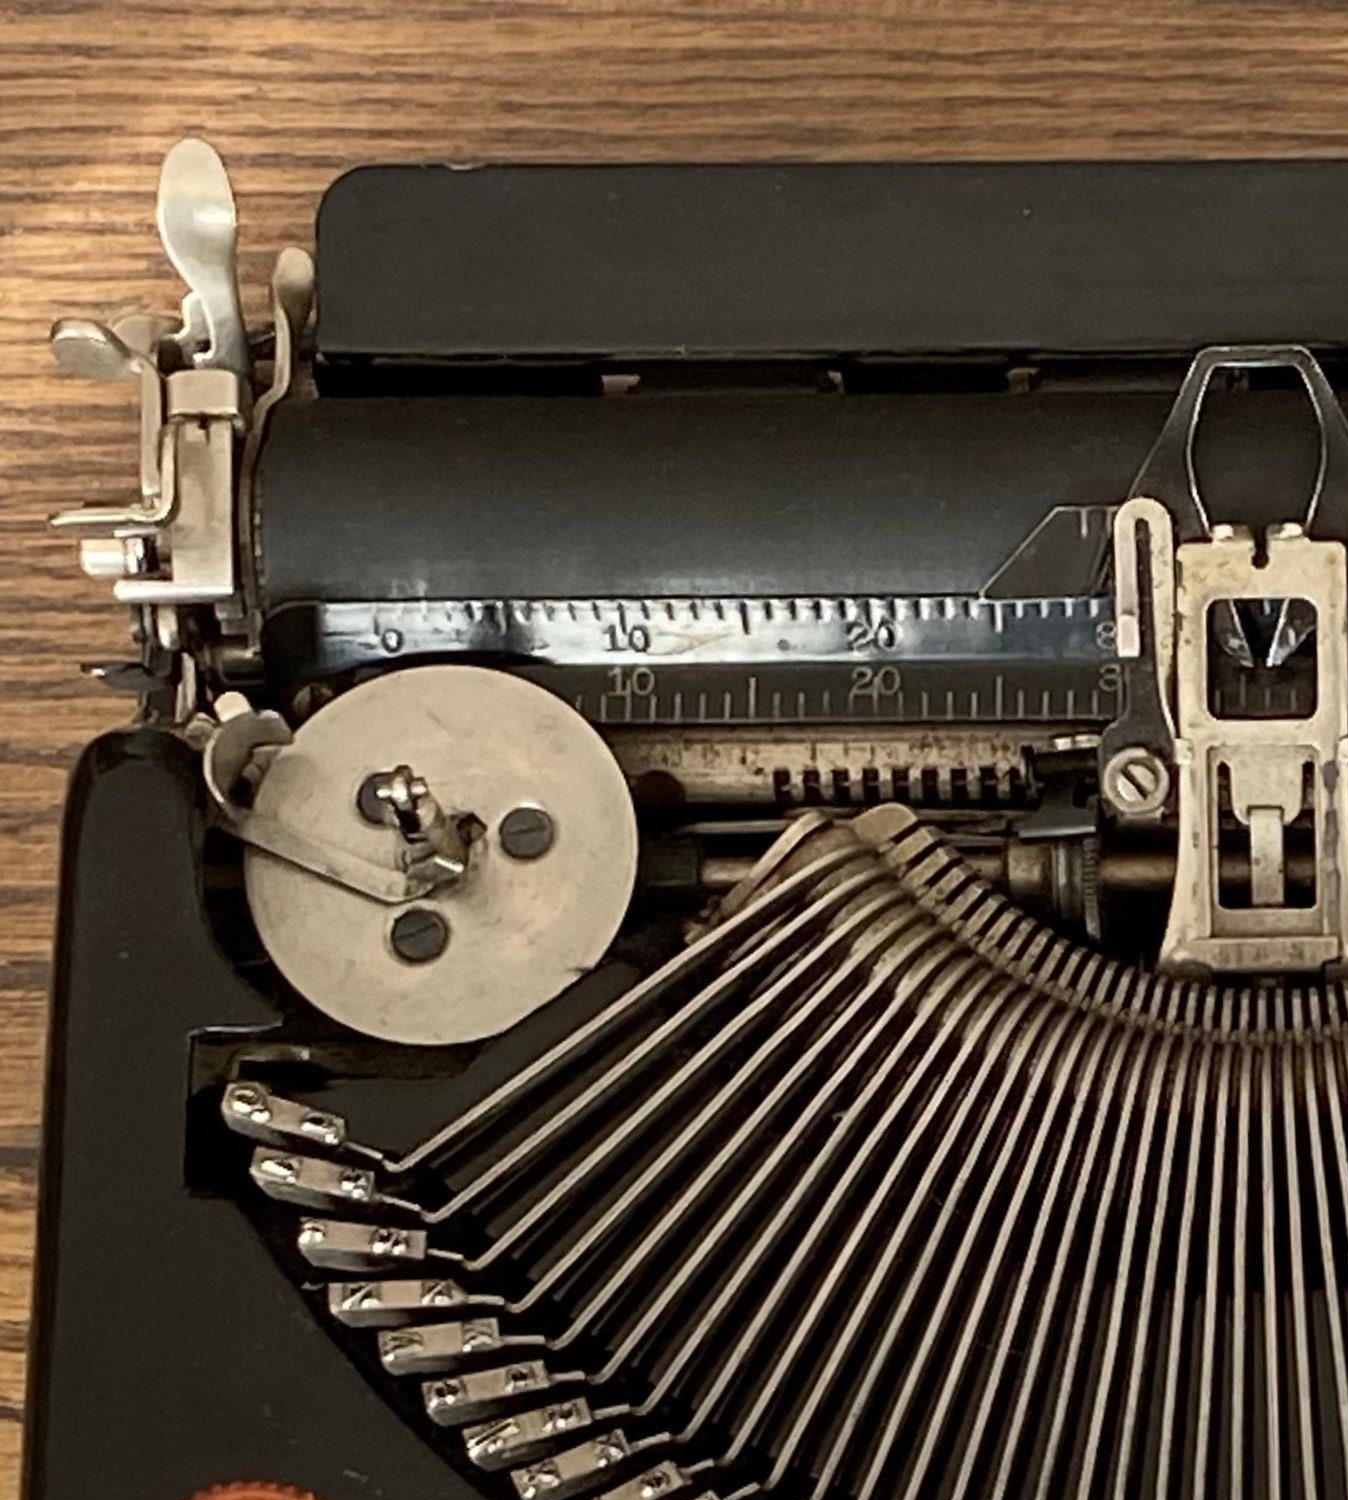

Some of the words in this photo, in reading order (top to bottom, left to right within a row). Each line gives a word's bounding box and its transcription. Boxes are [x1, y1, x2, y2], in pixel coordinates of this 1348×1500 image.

[602, 623, 651, 655] 10
[846, 622, 897, 653] 20
[606, 667, 655, 696] 10
[850, 666, 900, 697] 20
